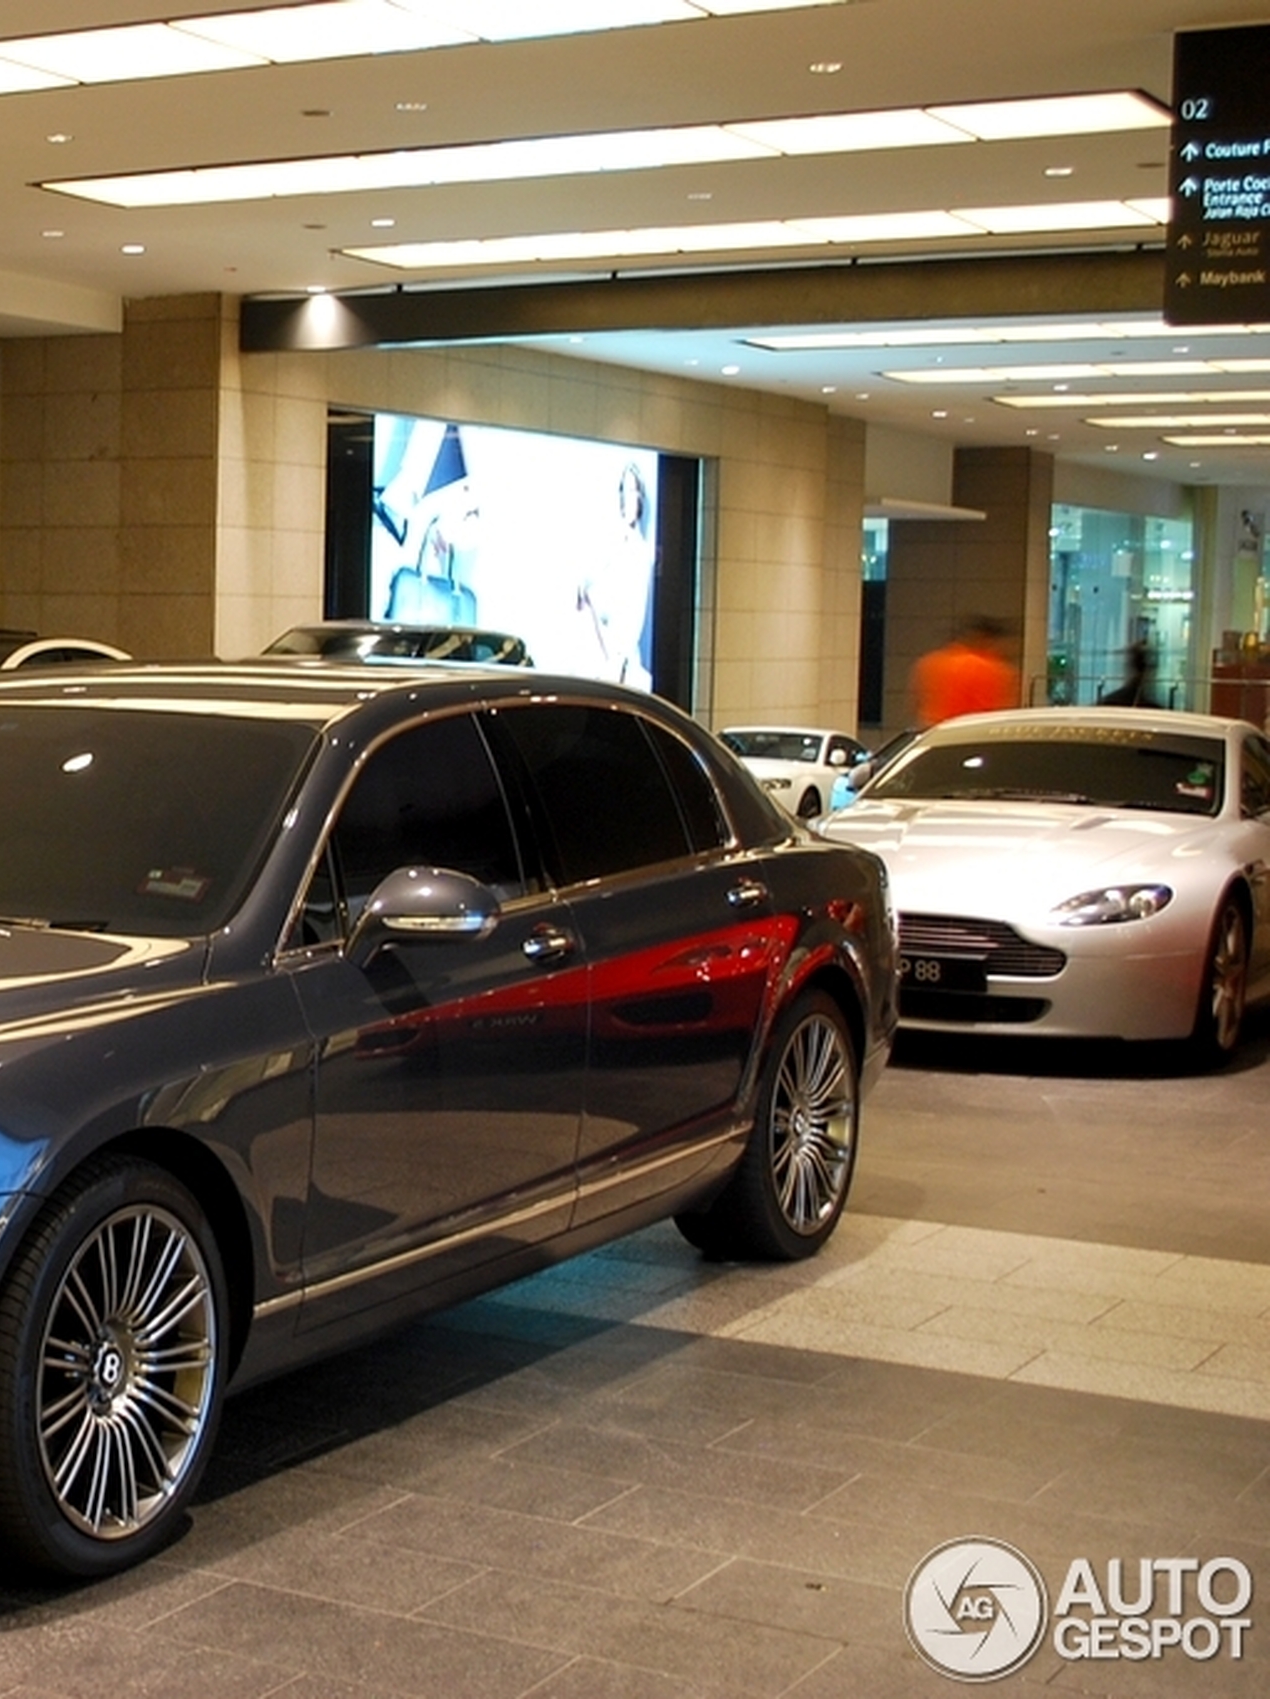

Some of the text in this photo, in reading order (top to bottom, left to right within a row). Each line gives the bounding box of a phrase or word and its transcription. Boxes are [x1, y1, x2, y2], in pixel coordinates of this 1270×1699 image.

[1181, 99, 1209, 119] 02
[1205, 143, 1260, 159] Couture
[1204, 178, 1240, 192] Porte
[1203, 192, 1263, 207] Entrance
[1201, 231, 1261, 249] Jaguar
[1199, 268, 1266, 288] Maybank
[914, 959, 941, 983] 88
